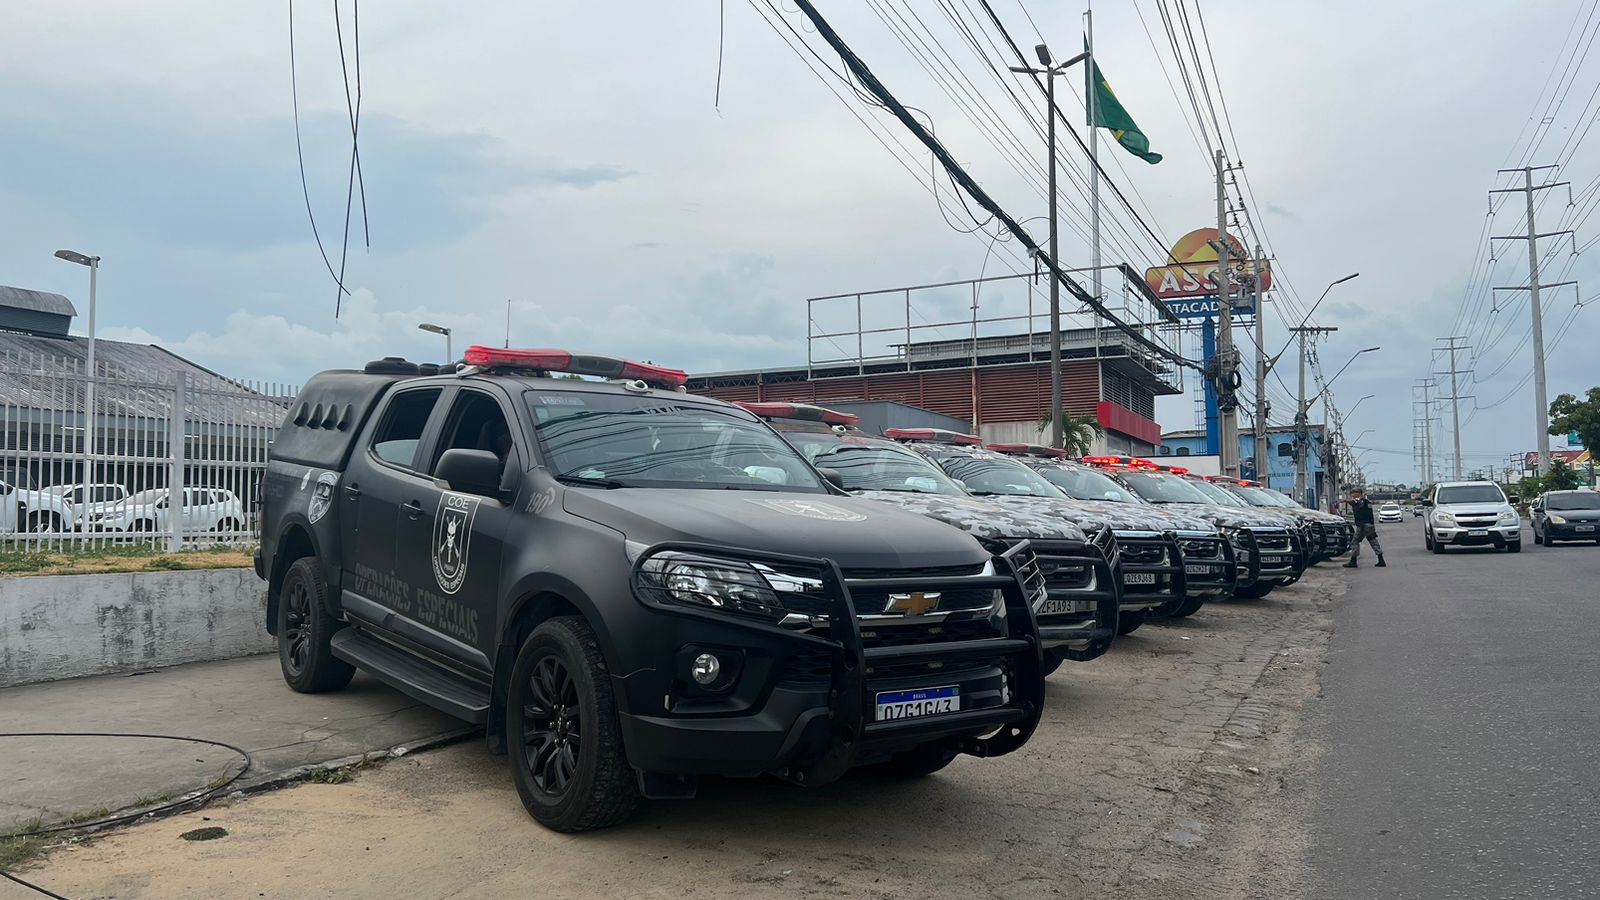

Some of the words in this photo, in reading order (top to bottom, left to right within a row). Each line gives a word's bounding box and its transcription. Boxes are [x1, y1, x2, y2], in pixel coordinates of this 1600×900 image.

[447, 496, 470, 510] COE
[525, 492, 550, 514] 190
[1040, 600, 1072, 613] ZF1A93
[416, 587, 479, 645] ESPECIAIS
